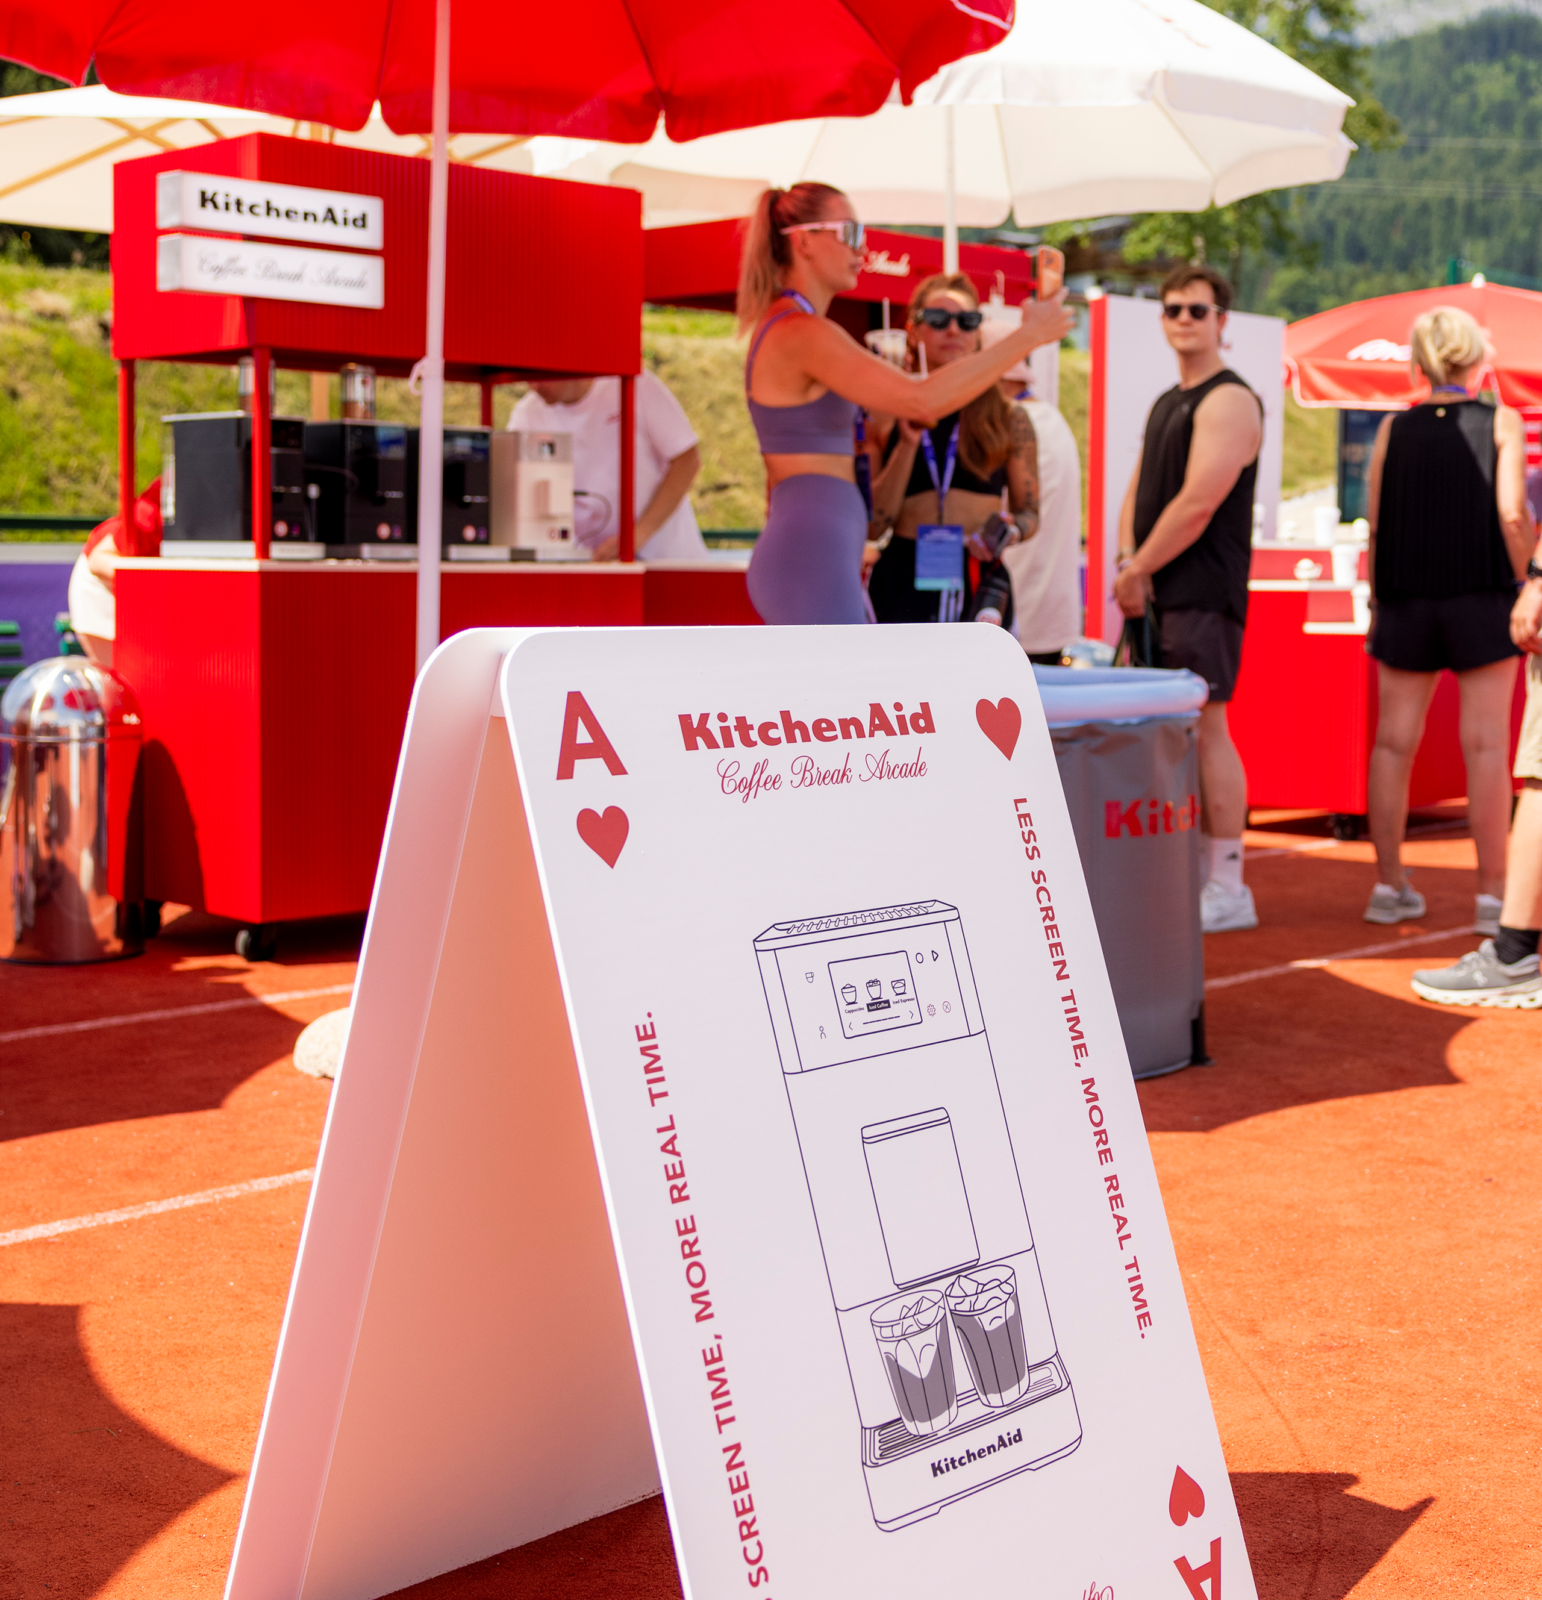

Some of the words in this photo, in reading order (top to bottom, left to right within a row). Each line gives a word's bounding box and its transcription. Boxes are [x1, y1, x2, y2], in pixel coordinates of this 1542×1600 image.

[199, 190, 368, 229] KitchenAid
[556, 691, 628, 780] A
[678, 702, 936, 751] KitchenAid
[717, 758, 782, 803] Coffee
[791, 752, 853, 788] Break
[859, 747, 928, 782] Arcade
[634, 1011, 669, 1107] TIME.
[1013, 798, 1041, 861] LESS
[1031, 869, 1070, 981] SCREEN
[1061, 988, 1089, 1068] TIME,
[1081, 1077, 1114, 1166] MORE
[1103, 1174, 1132, 1251] REAL
[1124, 1255, 1153, 1339] TIME.
[656, 1114, 690, 1205] REAL
[675, 1214, 716, 1324] MORE
[701, 1333, 736, 1435] TIME,
[930, 1428, 1024, 1478] KitchenAid
[722, 1441, 769, 1588] SCREEN
[1173, 1536, 1221, 1600] A
